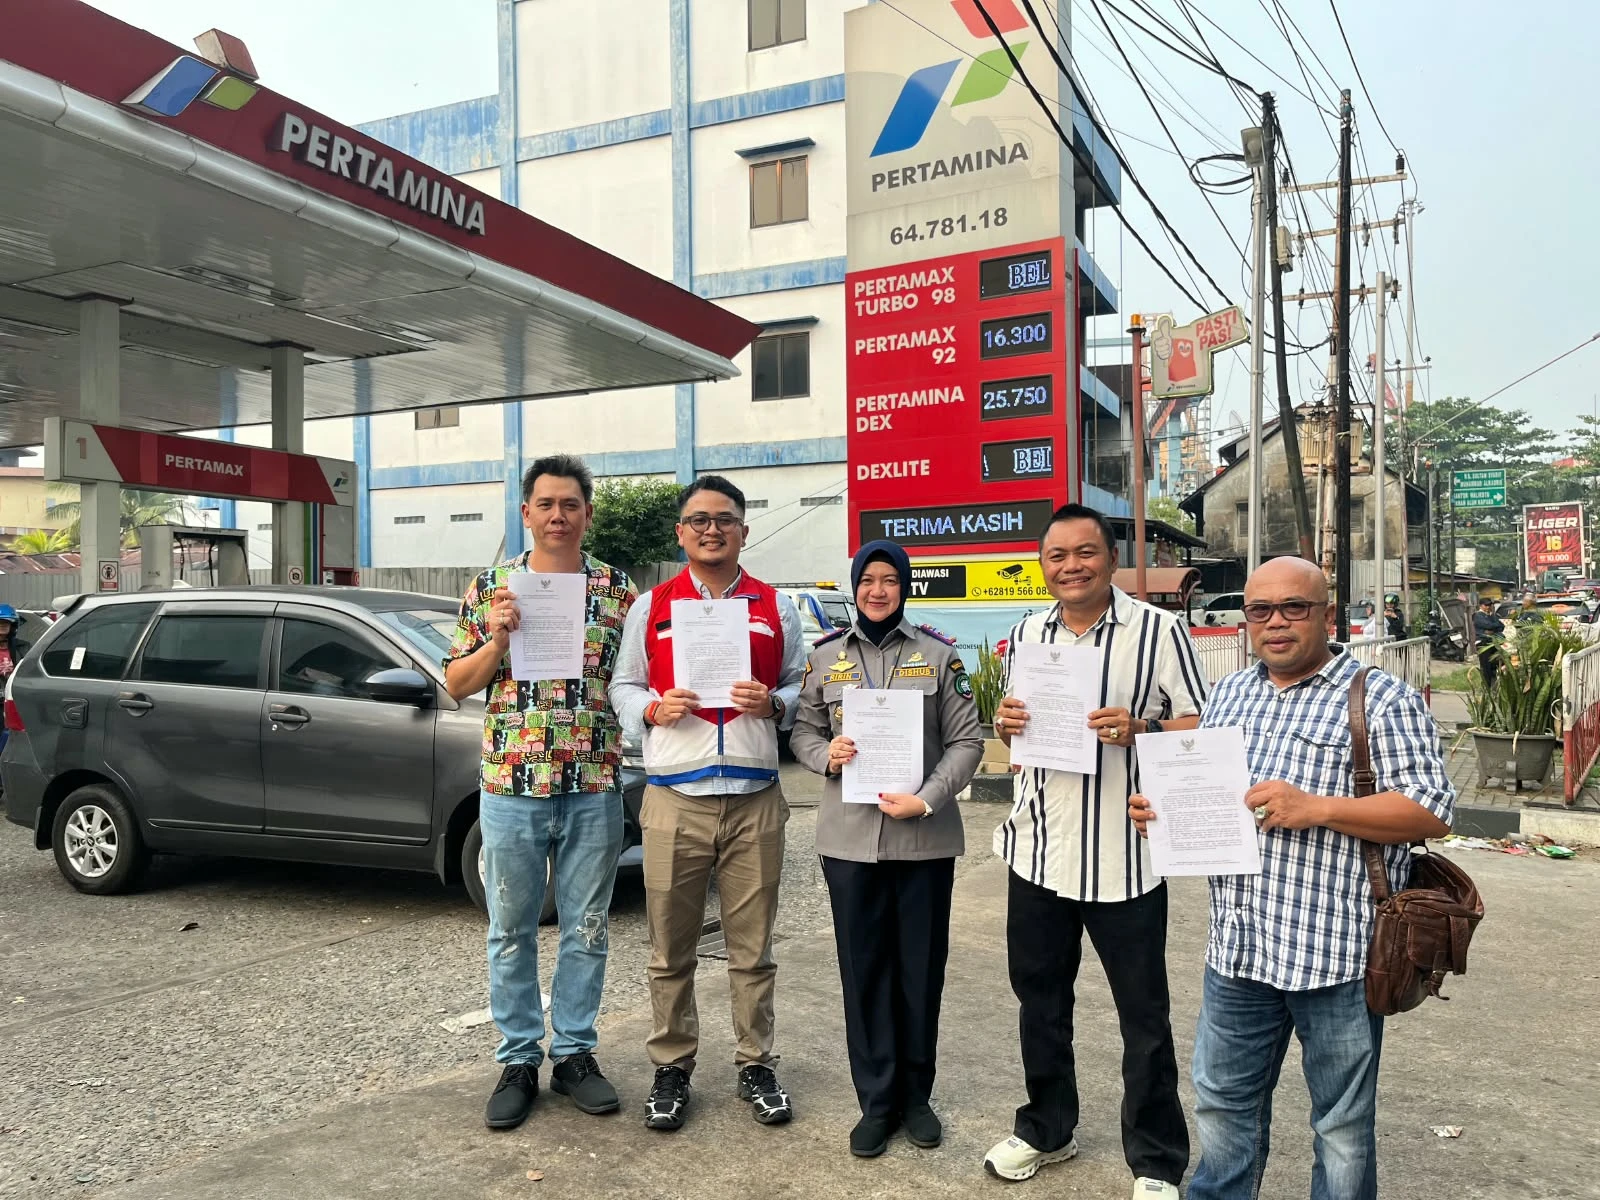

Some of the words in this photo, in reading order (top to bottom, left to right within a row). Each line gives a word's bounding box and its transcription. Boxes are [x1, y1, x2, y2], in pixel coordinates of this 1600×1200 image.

[282, 112, 486, 236] PERTAMINA
[871, 142, 1029, 192] PERTAMINA
[890, 207, 1008, 245] 64.781.18
[854, 265, 955, 299] PERTAMAX
[855, 293, 919, 317] TURBO
[931, 287, 956, 305] 98
[1196, 309, 1237, 337] PASTI
[855, 325, 956, 356] PERTAMAX
[984, 323, 1047, 349] 16.300
[1199, 326, 1232, 350] PAS!
[931, 347, 956, 365] 92
[855, 386, 965, 413] PERTAMINA
[983, 386, 1047, 410] 25.750
[856, 413, 893, 433] DEX
[76, 437, 87, 459] 1
[165, 454, 244, 477] PERTAMAX
[856, 459, 931, 481] DEXLITE
[880, 516, 956, 538] TERIMA
[960, 511, 1023, 534] KASIH
[1528, 517, 1578, 530] LIGER
[1546, 535, 1562, 550] 16
[911, 568, 949, 579] DIAWASI
[910, 581, 929, 596] TV
[983, 587, 1015, 596] +62819
[1017, 586, 1033, 596] 566
[1035, 586, 1050, 595] 08
[900, 667, 931, 676] DISHUB
